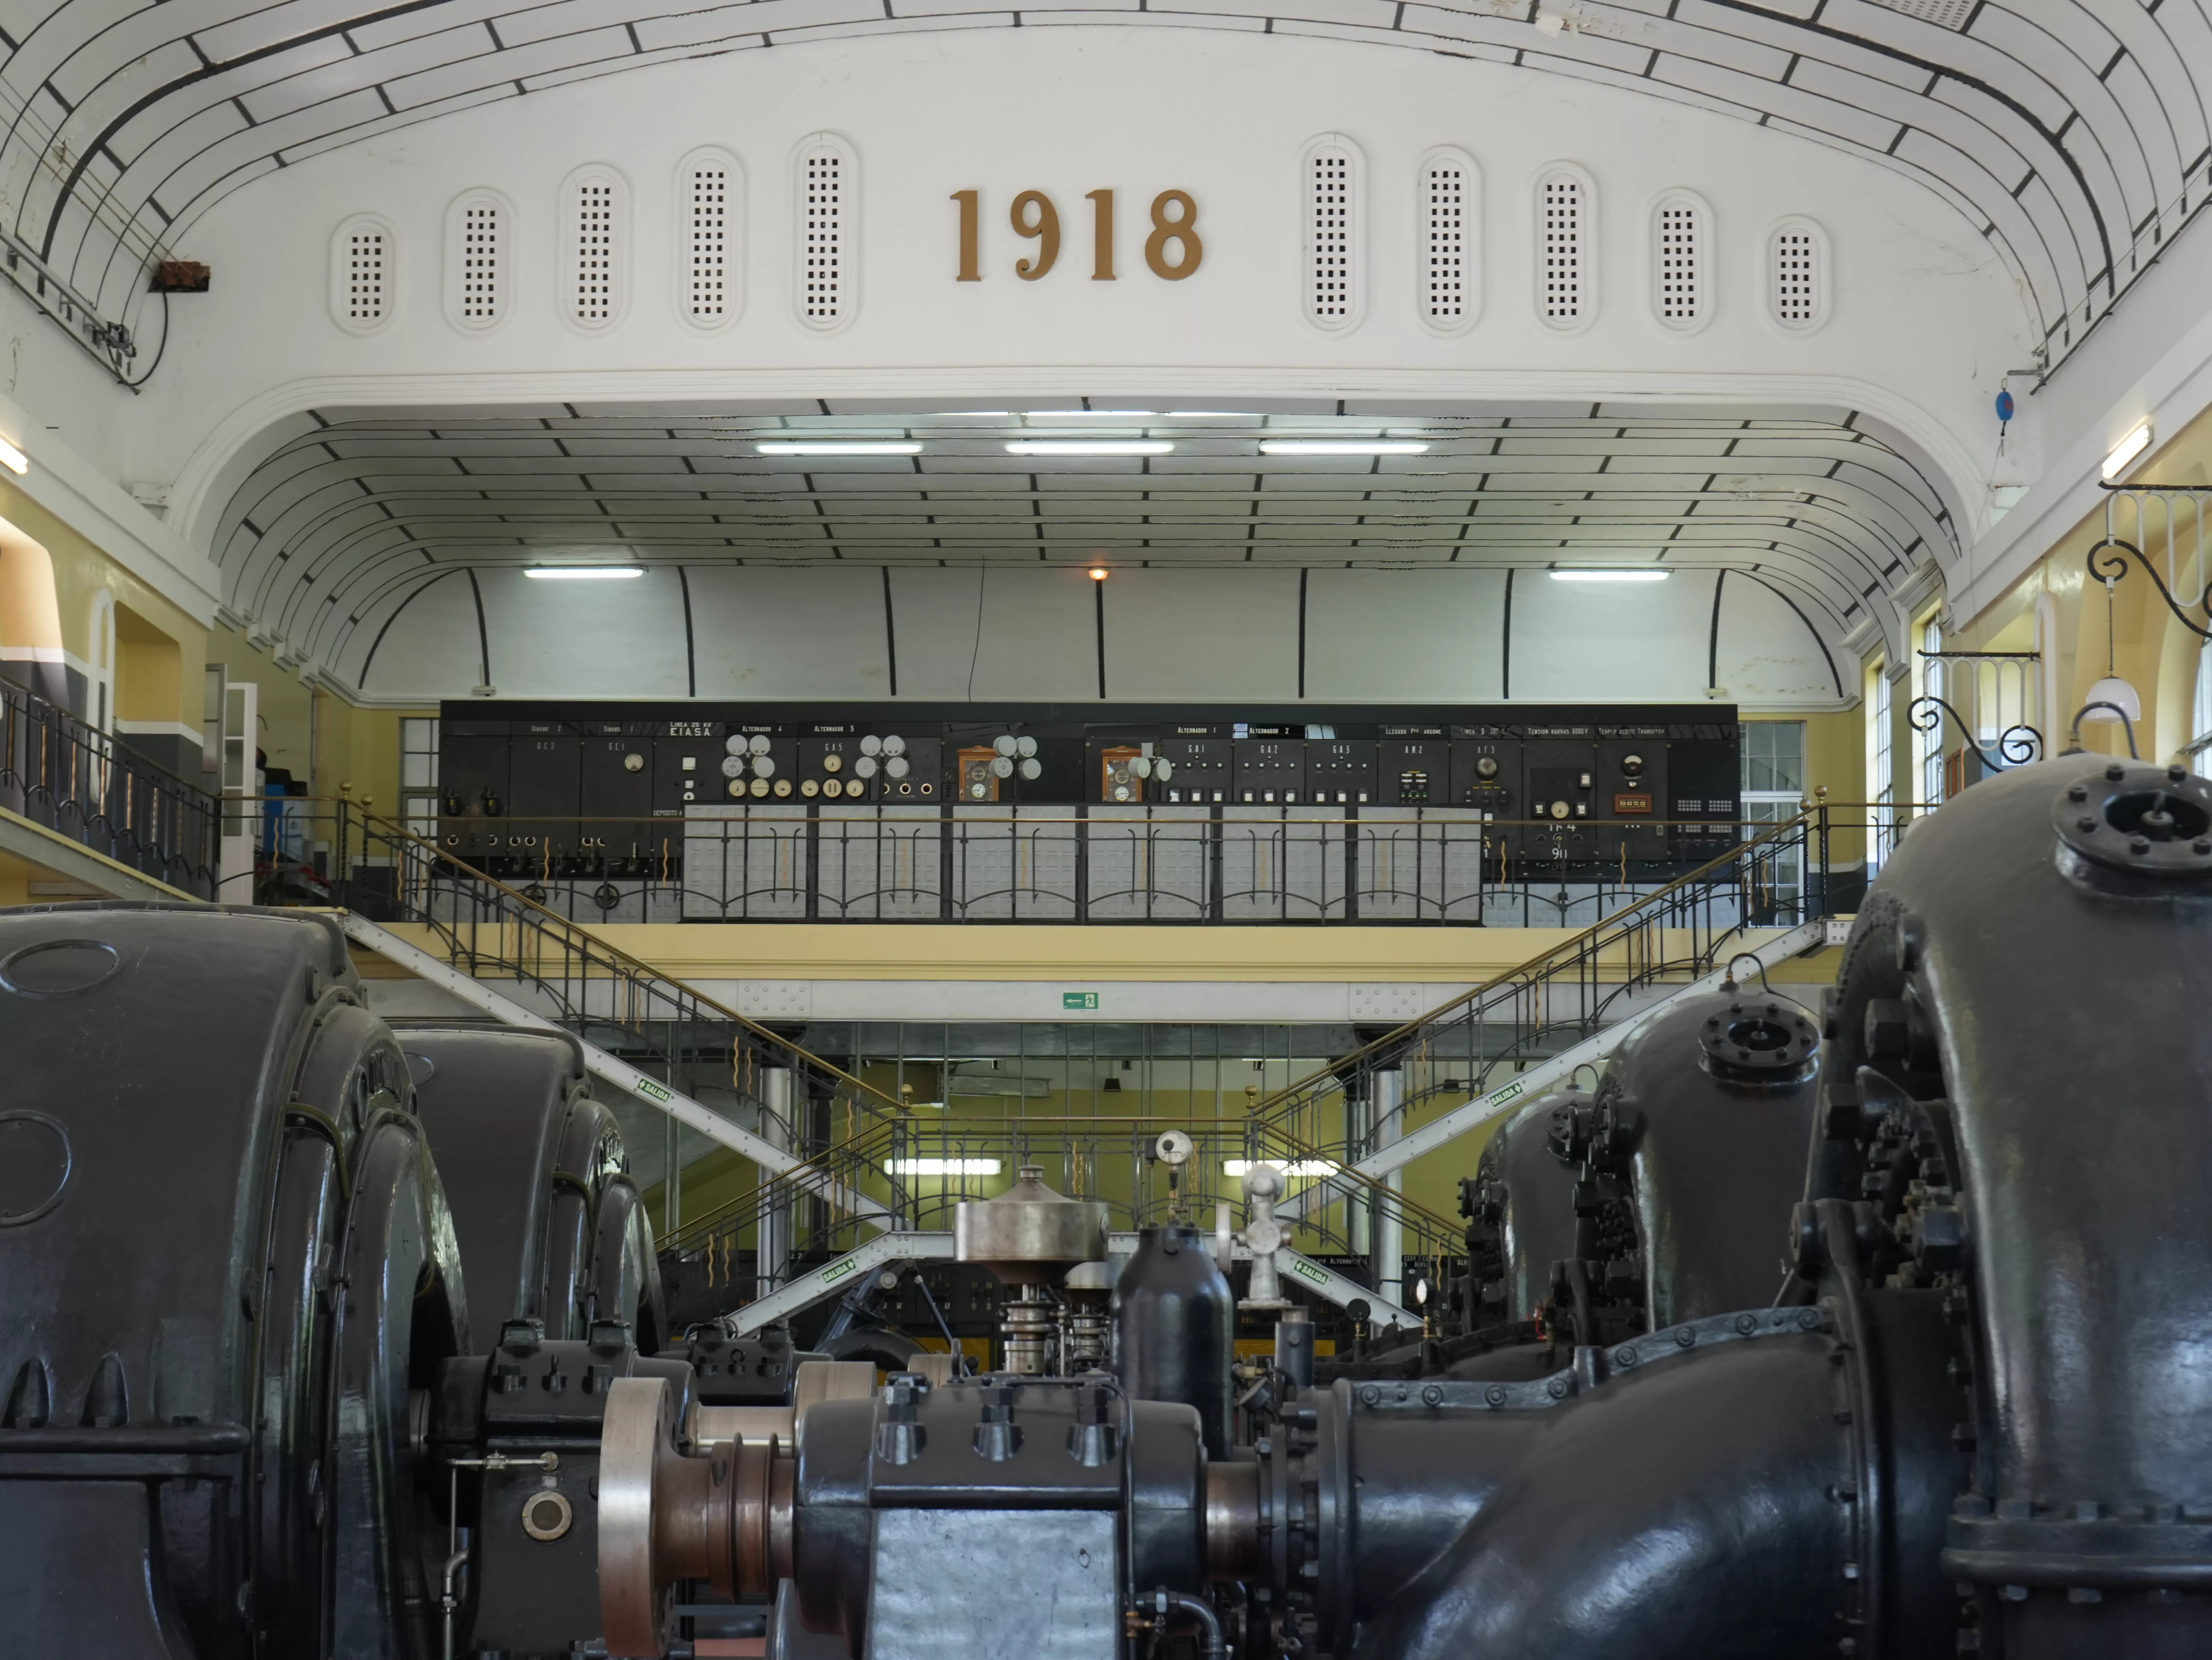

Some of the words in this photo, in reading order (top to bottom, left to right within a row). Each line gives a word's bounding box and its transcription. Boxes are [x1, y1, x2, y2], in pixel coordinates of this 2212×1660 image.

[950, 189, 1203, 282] 1918
[645, 1084, 669, 1101] SALIDA
[1491, 1088, 1515, 1105] SALIDA
[823, 1264, 849, 1282] SALIDA
[1301, 1265, 1326, 1283] SALIDA
